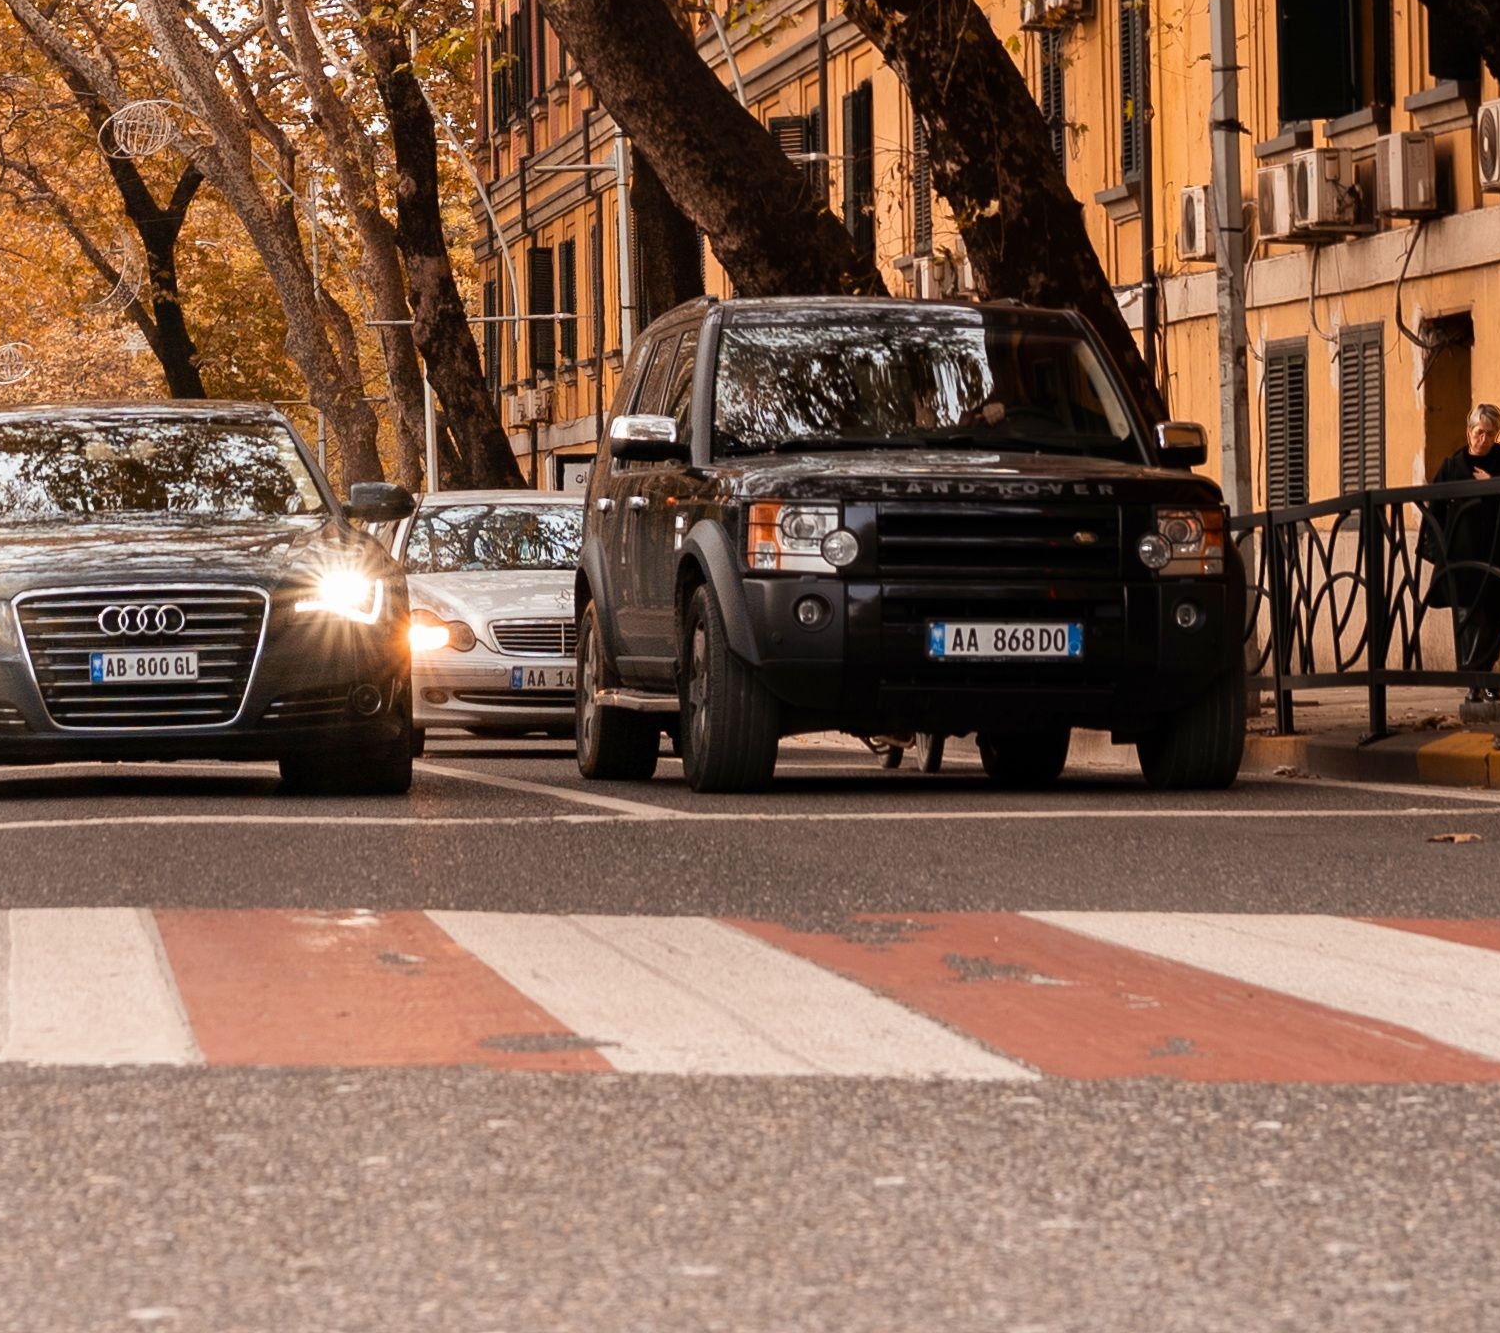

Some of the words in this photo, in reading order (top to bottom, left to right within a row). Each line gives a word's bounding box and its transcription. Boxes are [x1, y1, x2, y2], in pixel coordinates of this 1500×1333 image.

[881, 481, 976, 494] LAND
[997, 482, 1115, 495] ROVER
[951, 627, 979, 652] AA
[106, 658, 127, 677] AB
[136, 657, 169, 676] 800
[174, 656, 195, 675] GL
[527, 670, 546, 687] AA
